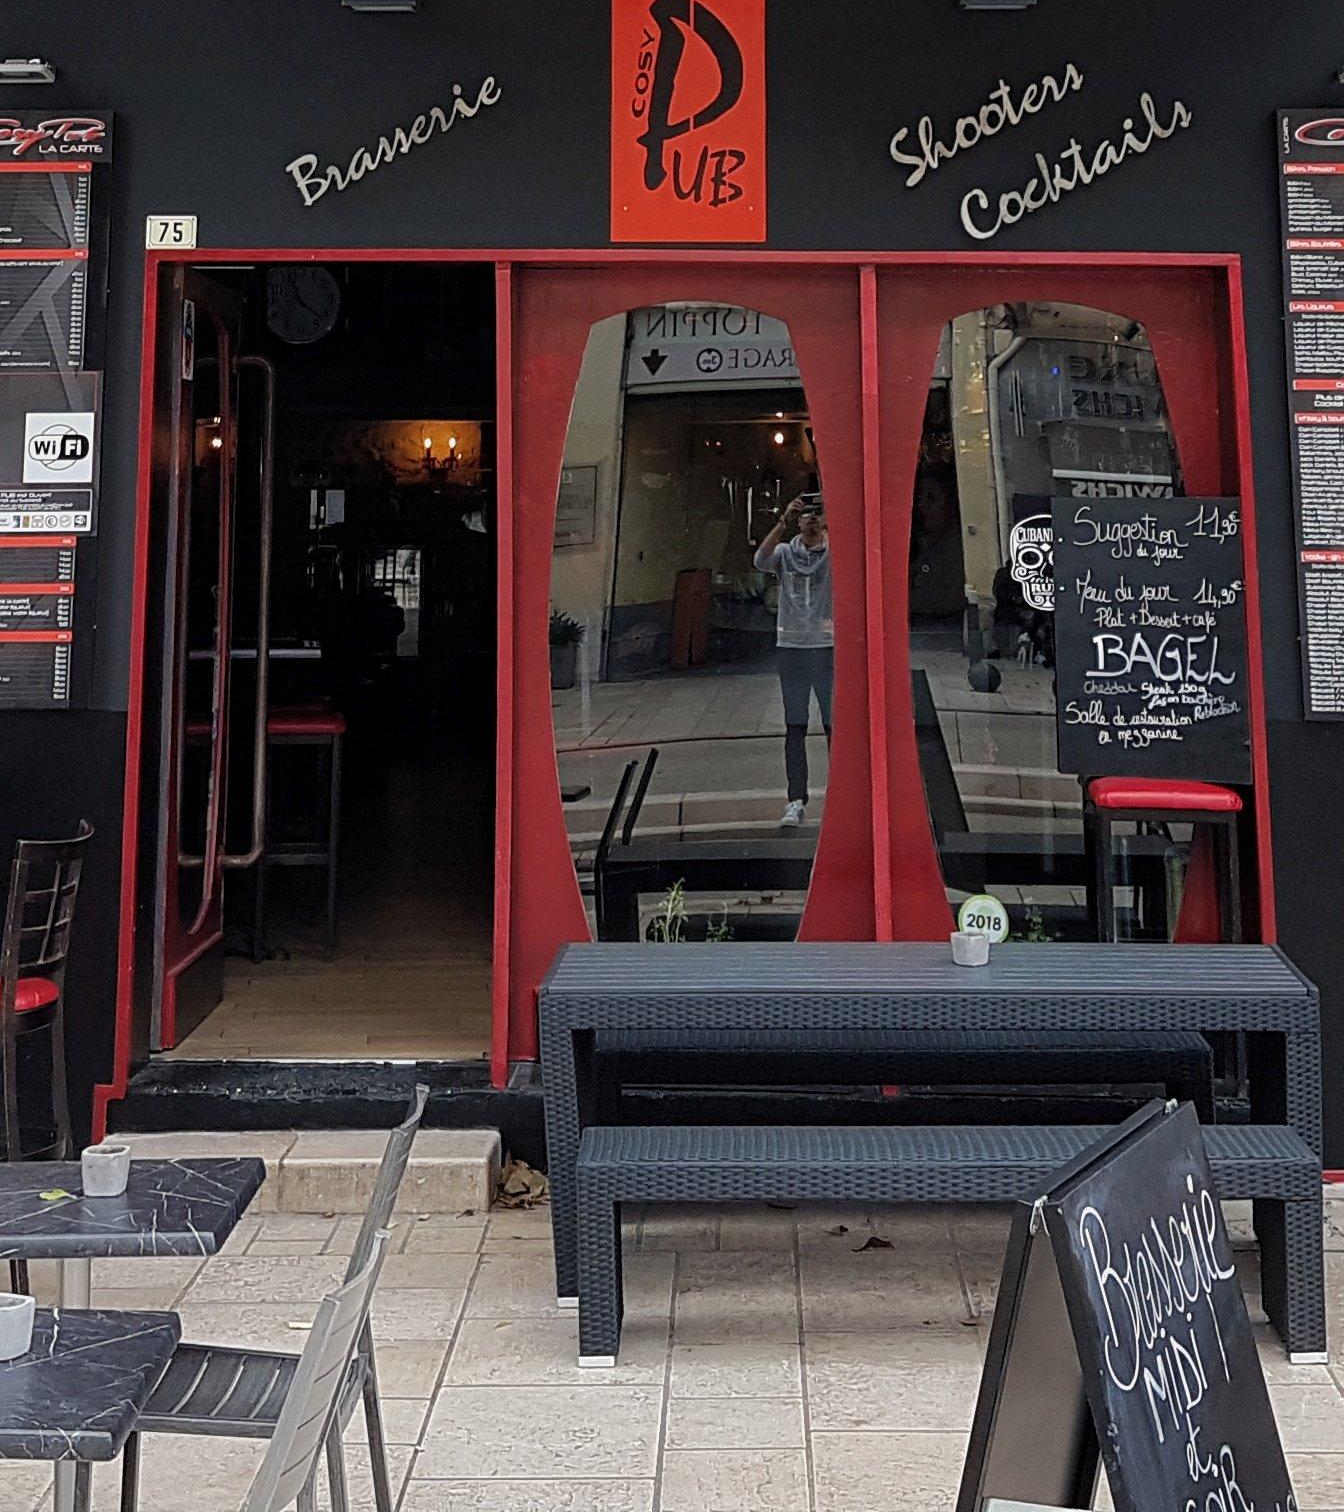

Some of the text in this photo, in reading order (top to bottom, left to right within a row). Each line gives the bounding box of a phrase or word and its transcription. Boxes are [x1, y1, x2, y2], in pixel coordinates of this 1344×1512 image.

[631, 27, 656, 118] COSY
[38, 144, 104, 153] LA CARTE
[285, 75, 502, 206] Brasserie
[889, 63, 1084, 187] Shooters
[959, 91, 1193, 239] Cocktails
[157, 221, 185, 244] 75
[1072, 505, 1190, 559] Suggestion
[1136, 543, 1184, 567] du jour
[1076, 568, 1112, 615] Menu
[1114, 575, 1135, 603] du
[1138, 584, 1180, 612] jour
[1093, 606, 1127, 629] Plat
[1085, 632, 1236, 685] BAGEL
[1065, 699, 1110, 726] Salle
[1112, 704, 1127, 726] de
[966, 913, 1002, 931] 2018
[1078, 1173, 1235, 1391] Brasserie
